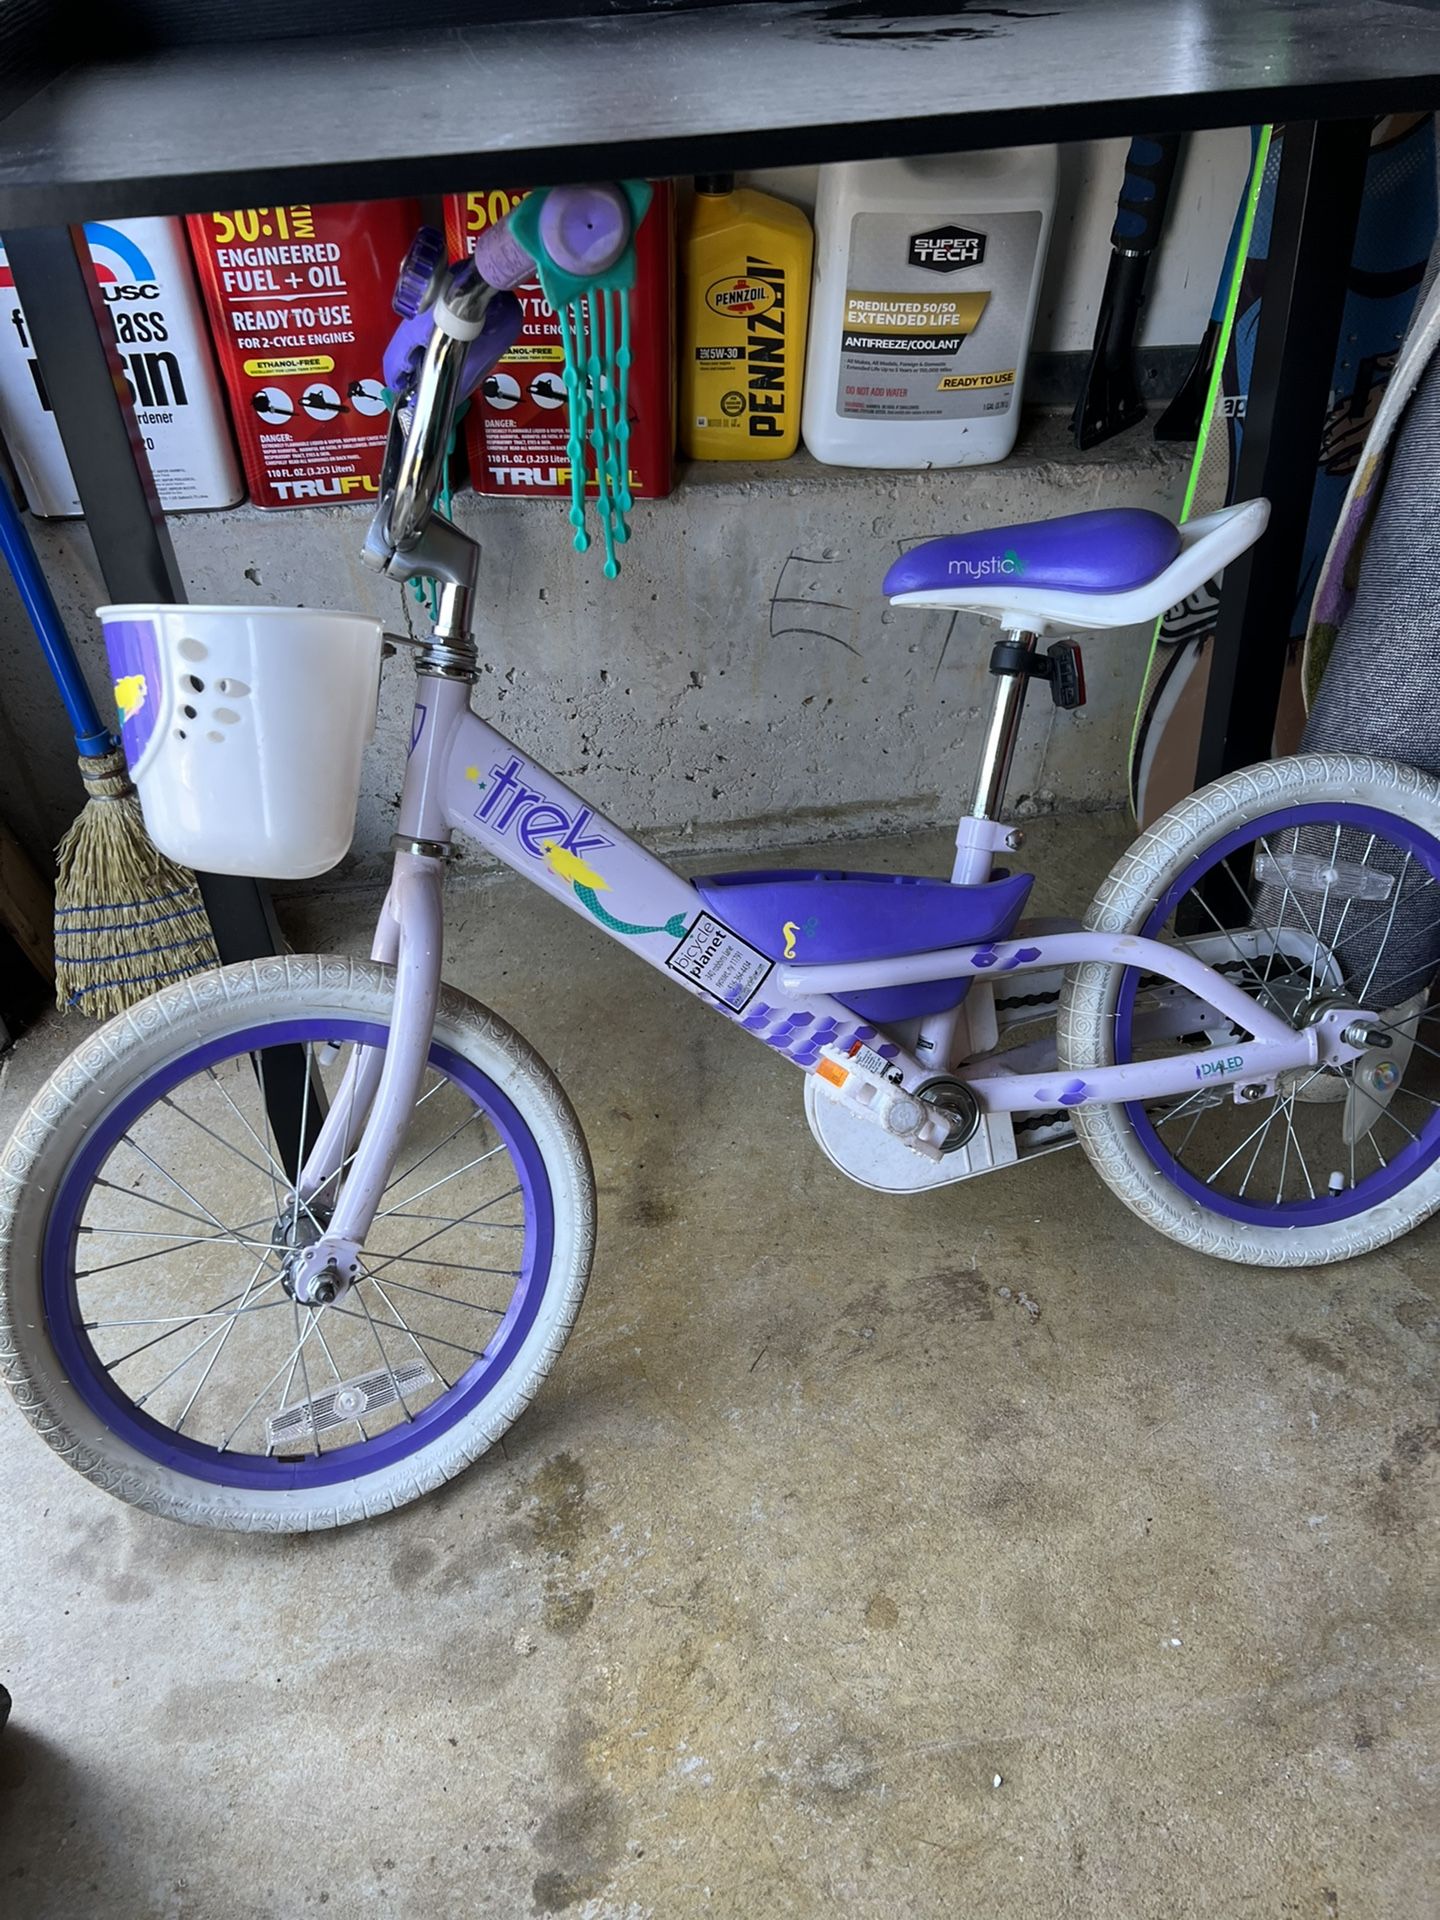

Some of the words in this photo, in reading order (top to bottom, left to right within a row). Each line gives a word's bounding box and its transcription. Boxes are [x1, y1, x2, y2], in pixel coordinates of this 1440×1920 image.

[914, 238, 979, 249] SUPER
[217, 243, 341, 268] ENGINEERED
[914, 248, 978, 262] TECH
[223, 269, 280, 292] FUEL
[285, 272, 303, 289] +
[309, 266, 346, 287] OIL
[101, 284, 160, 301] USC
[716, 287, 766, 306] PENNZOIL
[530, 298, 553, 317] TO
[849, 300, 920, 312] PREDILUTED
[923, 303, 956, 313] 50/50
[232, 309, 289, 331] READY
[292, 307, 315, 328] TO
[319, 305, 352, 326] USE
[847, 311, 926, 326] EXTENDED
[930, 313, 960, 325] LIFE
[238, 338, 261, 349] FOR
[262, 335, 306, 348] 2-CYCLE
[308, 332, 355, 345] ENGINES
[845, 337, 960, 351] ANTIFREEZE/COOLANT
[710, 348, 738, 358] 5W-30
[257, 358, 320, 369] ETHANOL-FREE
[943, 375, 978, 388] READY
[980, 374, 992, 385] TO
[995, 373, 1013, 383] USE
[846, 386, 856, 394] DO
[857, 387, 869, 395] NOT
[870, 387, 884, 396] ADD
[886, 388, 907, 397] WATER
[138, 411, 173, 424] rdener
[485, 420, 517, 428] DANGER:
[260, 434, 293, 443] DANGER:
[487, 455, 500, 463] 110
[501, 455, 513, 463] FL.
[513, 455, 525, 464] OZ.
[526, 455, 549, 464] (3.253
[550, 455, 571, 464] Liters
[267, 470, 281, 478] 110
[282, 468, 294, 477] FL.
[294, 468, 306, 476] OZ.
[307, 466, 330, 476] (3.253
[331, 464, 355, 474] Liters)
[270, 475, 381, 500] TRUFU
[948, 555, 1015, 579] mystic
[473, 755, 615, 860] trek
[675, 922, 715, 969] bicycle
[690, 930, 727, 979] planet
